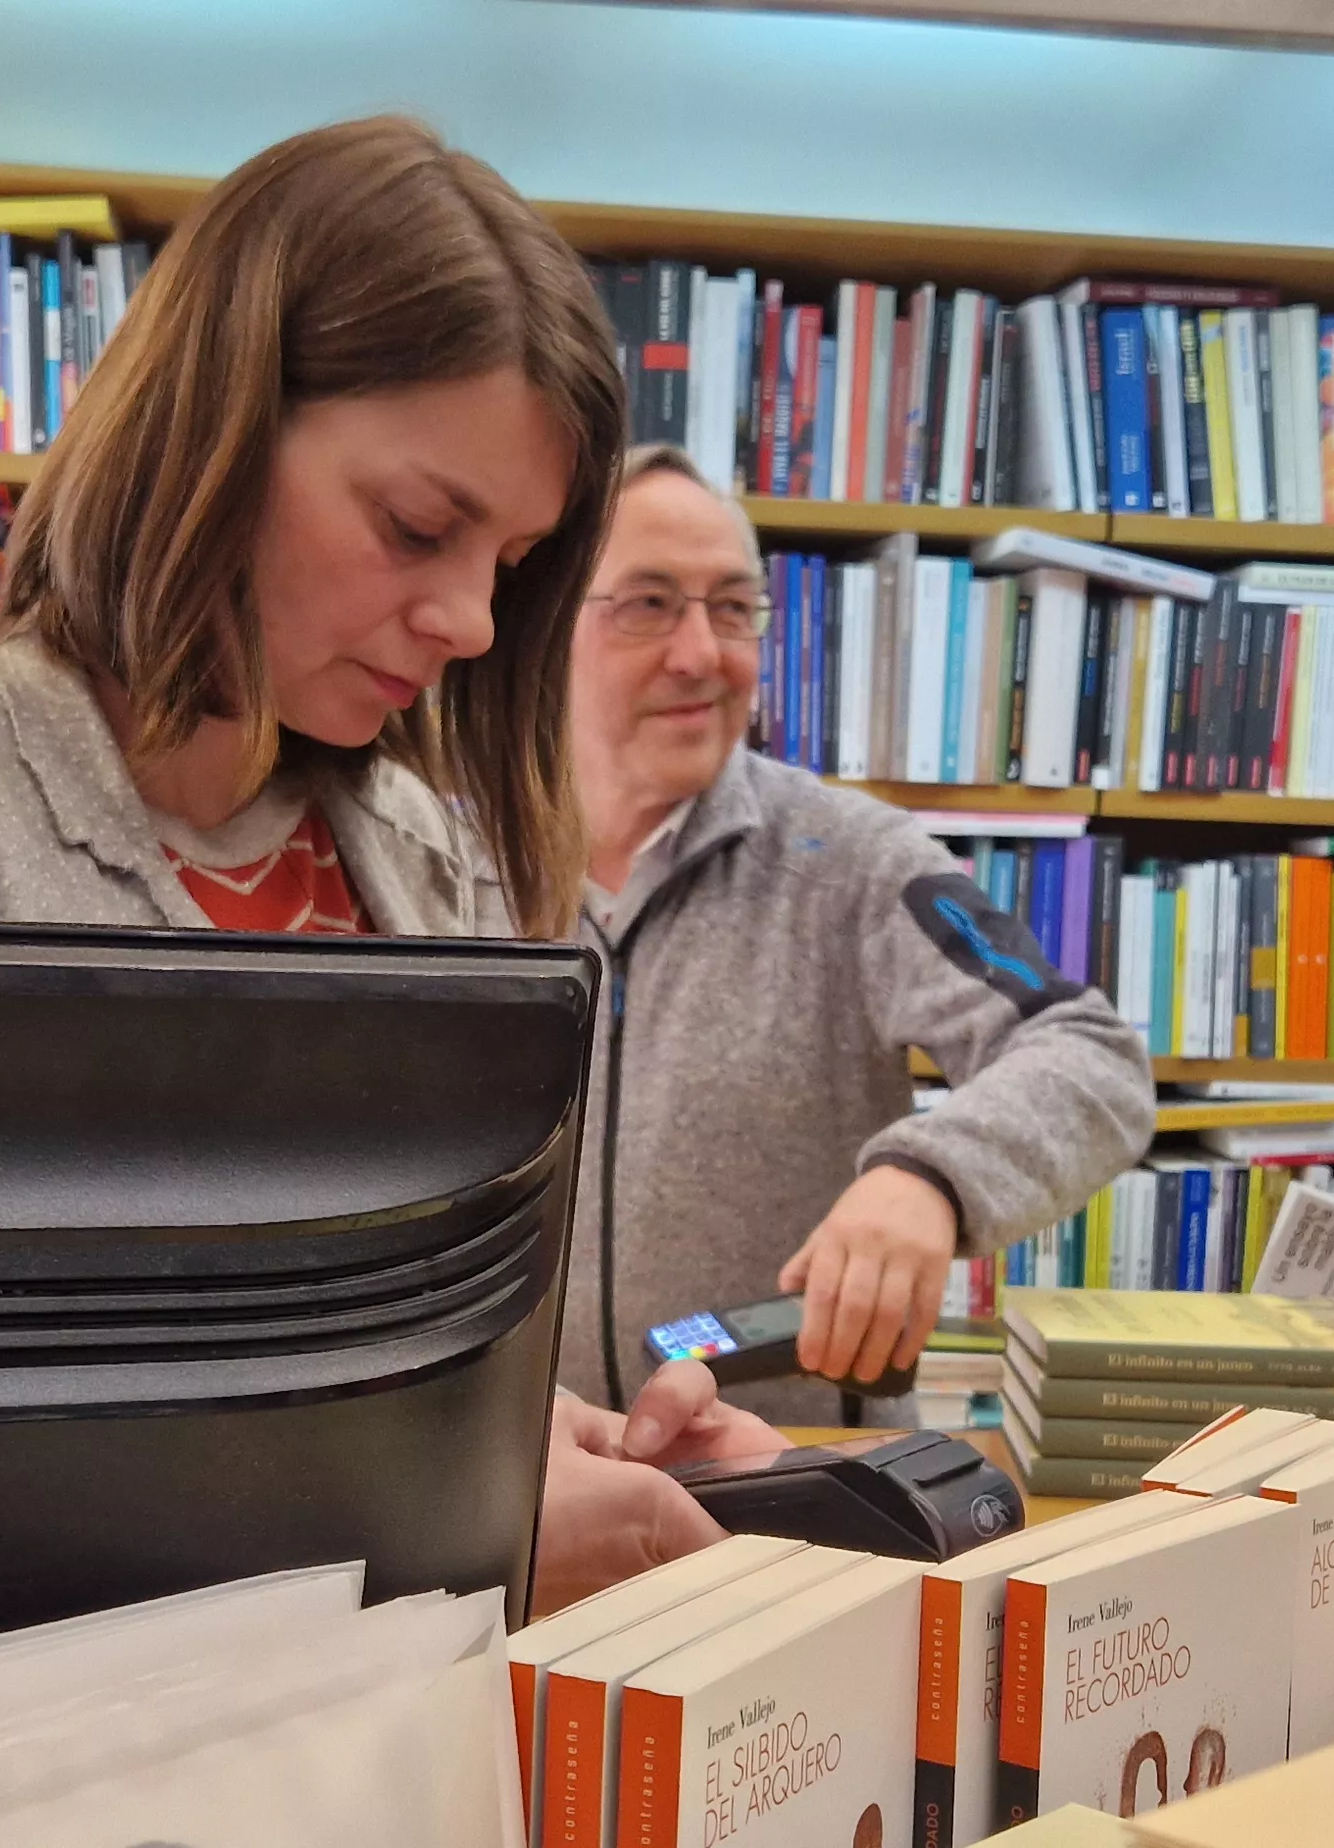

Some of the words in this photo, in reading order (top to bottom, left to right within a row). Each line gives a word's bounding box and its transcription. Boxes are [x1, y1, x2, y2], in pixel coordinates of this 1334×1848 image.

[1108, 1354, 1121, 1367] El
[1125, 1354, 1173, 1368] infinito
[1177, 1359, 1192, 1369] en
[1197, 1359, 1213, 1369] un
[1217, 1358, 1254, 1371] junco
[1103, 1393, 1117, 1406] El
[1120, 1394, 1168, 1408] infinito
[1172, 1400, 1187, 1410] en
[1192, 1401, 1209, 1410] un
[1103, 1434, 1117, 1446] El
[1120, 1434, 1168, 1448] infinito
[1091, 1473, 1105, 1486] El
[1312, 1517, 1334, 1536] Irene
[1068, 1610, 1096, 1635] Irene
[1099, 1598, 1134, 1627] Vallejo
[1311, 1578, 1332, 1609] DE
[930, 1617, 944, 1722] contraseña
[1016, 1620, 1029, 1724] contraseña
[1067, 1647, 1088, 1686] EL
[1094, 1616, 1170, 1676] FUTURO
[1065, 1645, 1192, 1723] RECORDADO
[706, 1717, 736, 1750] Irene
[739, 1696, 777, 1729] Vallejo
[564, 1720, 580, 1842] contraseña
[705, 1761, 724, 1805] EL
[733, 1711, 809, 1787] SILBIDO
[641, 1736, 656, 1845] ontraseña
[703, 1803, 738, 1848] DEL
[745, 1733, 843, 1826] ARQUERO
